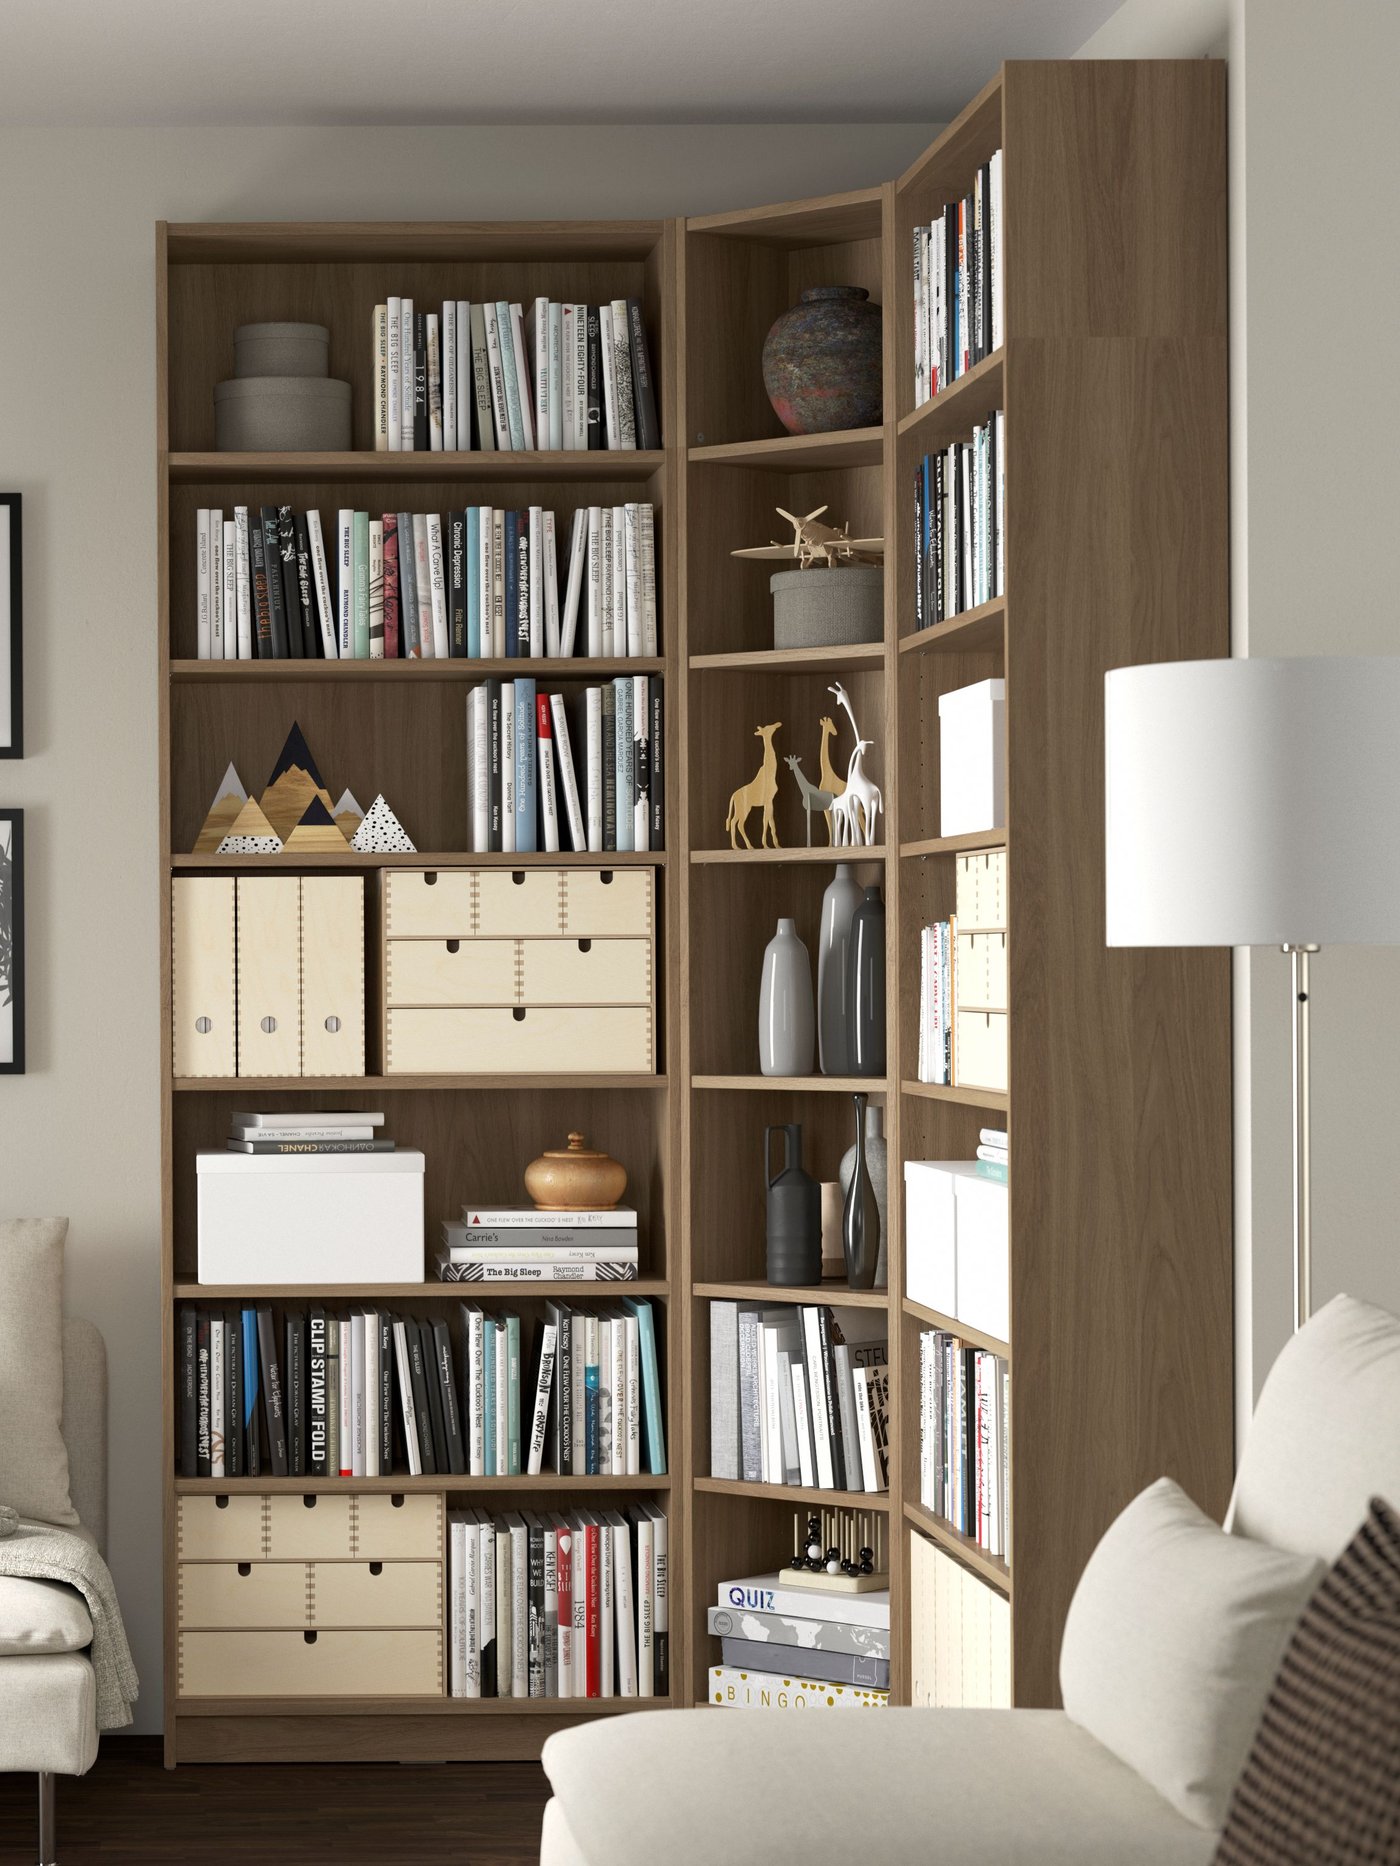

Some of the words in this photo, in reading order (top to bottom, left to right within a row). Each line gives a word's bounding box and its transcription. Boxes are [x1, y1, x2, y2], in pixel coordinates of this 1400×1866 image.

[577, 307, 585, 342] NINETEEN
[449, 346, 453, 354] OF
[474, 348, 482, 363] THE
[476, 368, 484, 380] BIG
[577, 345, 585, 395] EIGHTY-FOUR
[478, 385, 486, 411] SLEEP
[431, 524, 439, 544] What
[453, 522, 463, 549] Chronic
[433, 553, 441, 576] Carve
[452, 550, 462, 588] Depression
[358, 564, 366, 592] Grimm's
[433, 577, 443, 590] Up!
[356, 593, 366, 610] Fairy
[455, 609, 463, 622] Fritz
[625, 702, 633, 743] HUNDRED
[518, 731, 526, 741] of
[625, 745, 633, 773] YEARS
[518, 765, 526, 797] Hundred
[626, 775, 633, 786] OF
[278, 1144, 318, 1152] CHANEL
[466, 1233, 499, 1242] Carrie's
[487, 1268, 503, 1276] The
[504, 1268, 518, 1277] Big
[520, 1268, 542, 1278] Sleep
[553, 1272, 584, 1280] Chandler
[562, 1319, 570, 1331] Ken
[311, 1319, 325, 1354] CLIP
[561, 1332, 570, 1350] Kesey
[312, 1359, 325, 1414] STAMP
[312, 1421, 325, 1461] FOLD
[546, 1551, 555, 1566] KEN
[657, 1554, 666, 1566] THE
[546, 1569, 555, 1592] KESEY
[657, 1567, 666, 1577] BIG
[657, 1579, 666, 1598] SLEEP
[729, 1587, 776, 1610] QUIZ
[574, 1600, 585, 1629] 1984
[589, 1624, 597, 1637] Kesey
[727, 1686, 806, 1708] BINGO
